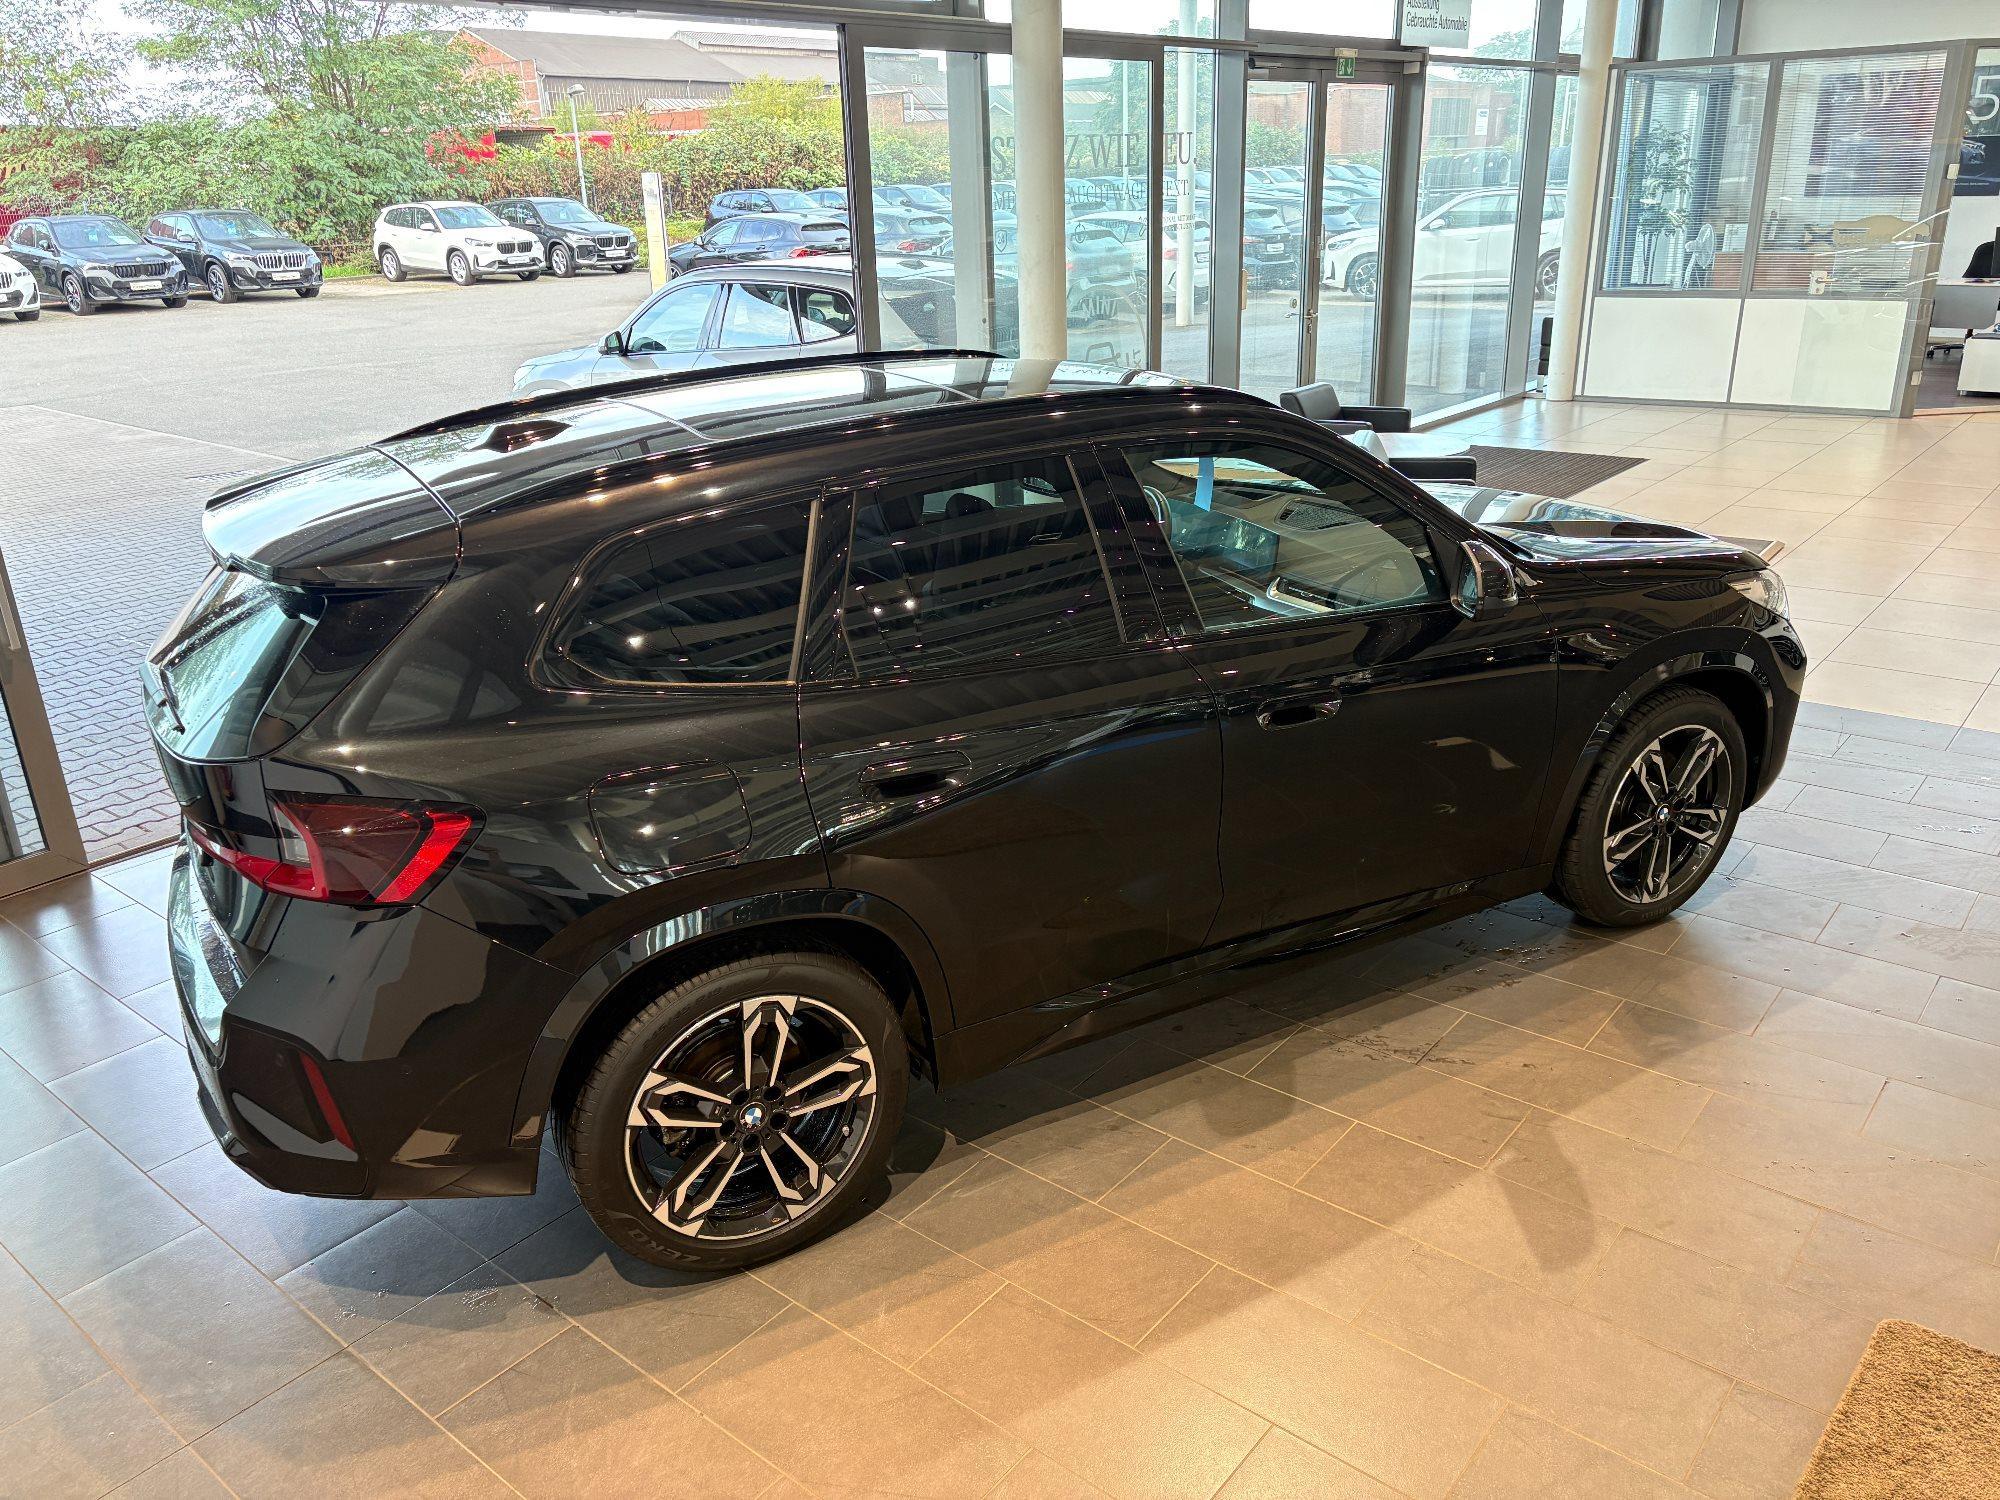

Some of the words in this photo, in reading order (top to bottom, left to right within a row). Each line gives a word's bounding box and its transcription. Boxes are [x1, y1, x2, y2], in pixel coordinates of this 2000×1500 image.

[1406, 11, 1438, 29] Gebrauchte
[1438, 14, 1468, 31] Automobile
[1085, 132, 1140, 168] WIE
